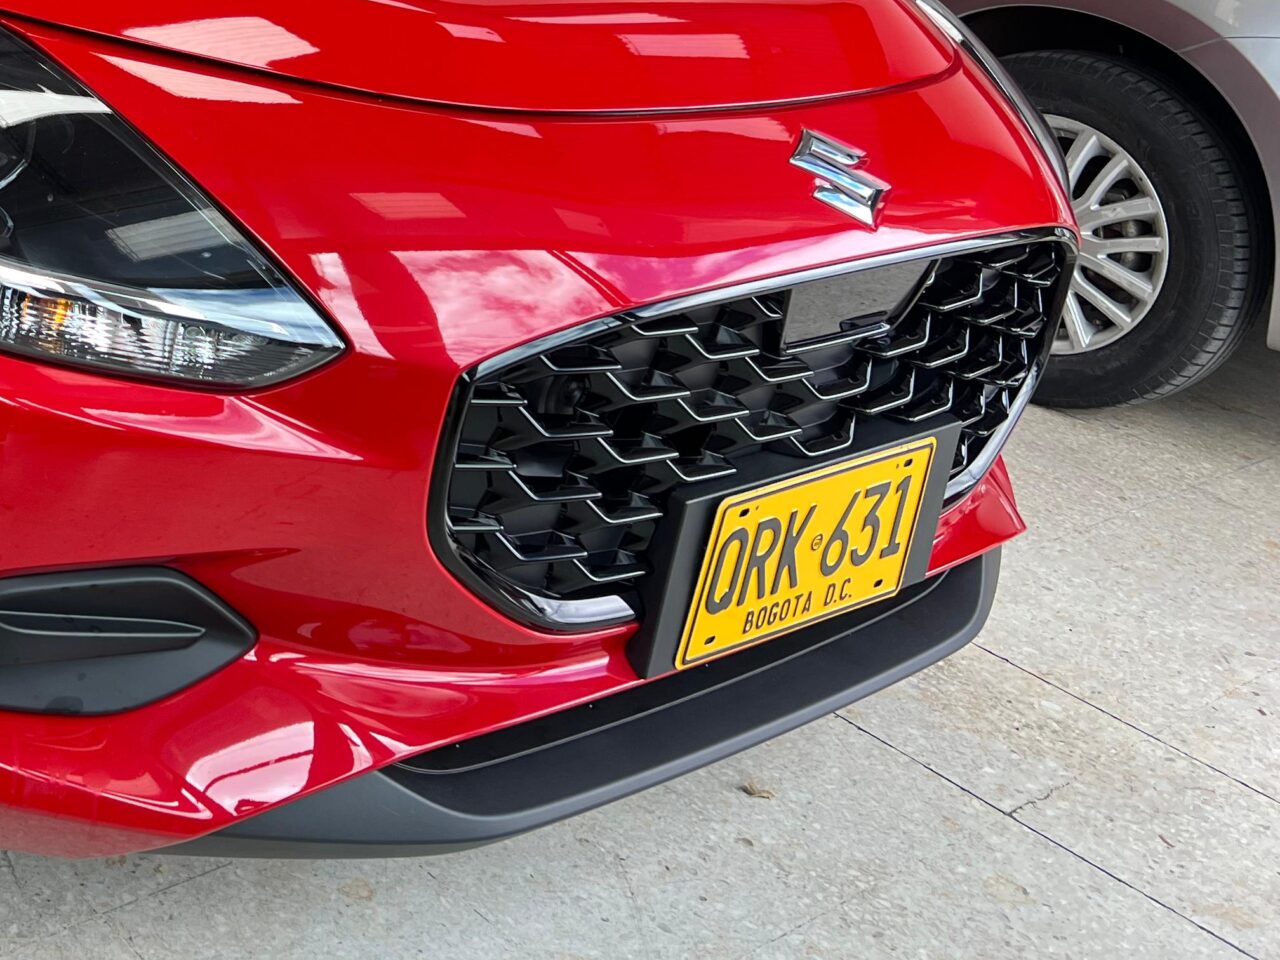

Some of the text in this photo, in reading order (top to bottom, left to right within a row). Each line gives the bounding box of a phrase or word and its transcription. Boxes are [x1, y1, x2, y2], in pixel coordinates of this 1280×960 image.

[704, 475, 912, 615] ORK 631
[742, 578, 852, 634] BOGOTA D.C.
